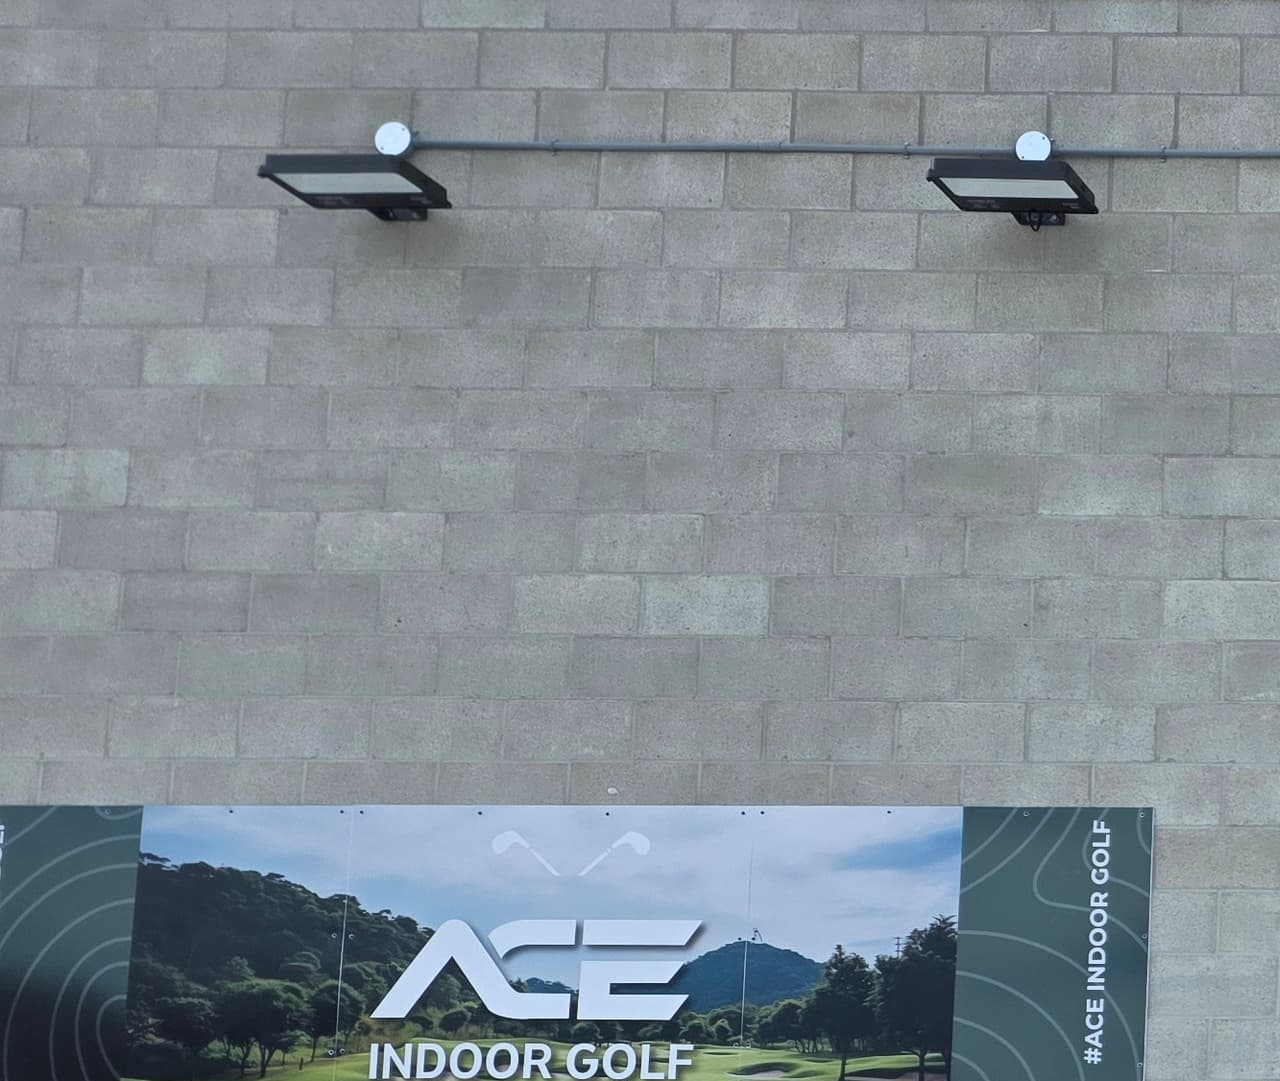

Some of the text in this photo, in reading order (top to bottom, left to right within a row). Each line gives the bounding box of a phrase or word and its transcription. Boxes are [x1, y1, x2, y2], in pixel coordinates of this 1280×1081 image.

[369, 918, 703, 1021] ACE
[1083, 819, 1111, 1065] #ACE INDOOR GOLF
[368, 1042, 694, 1080] INDOOR GOLF
